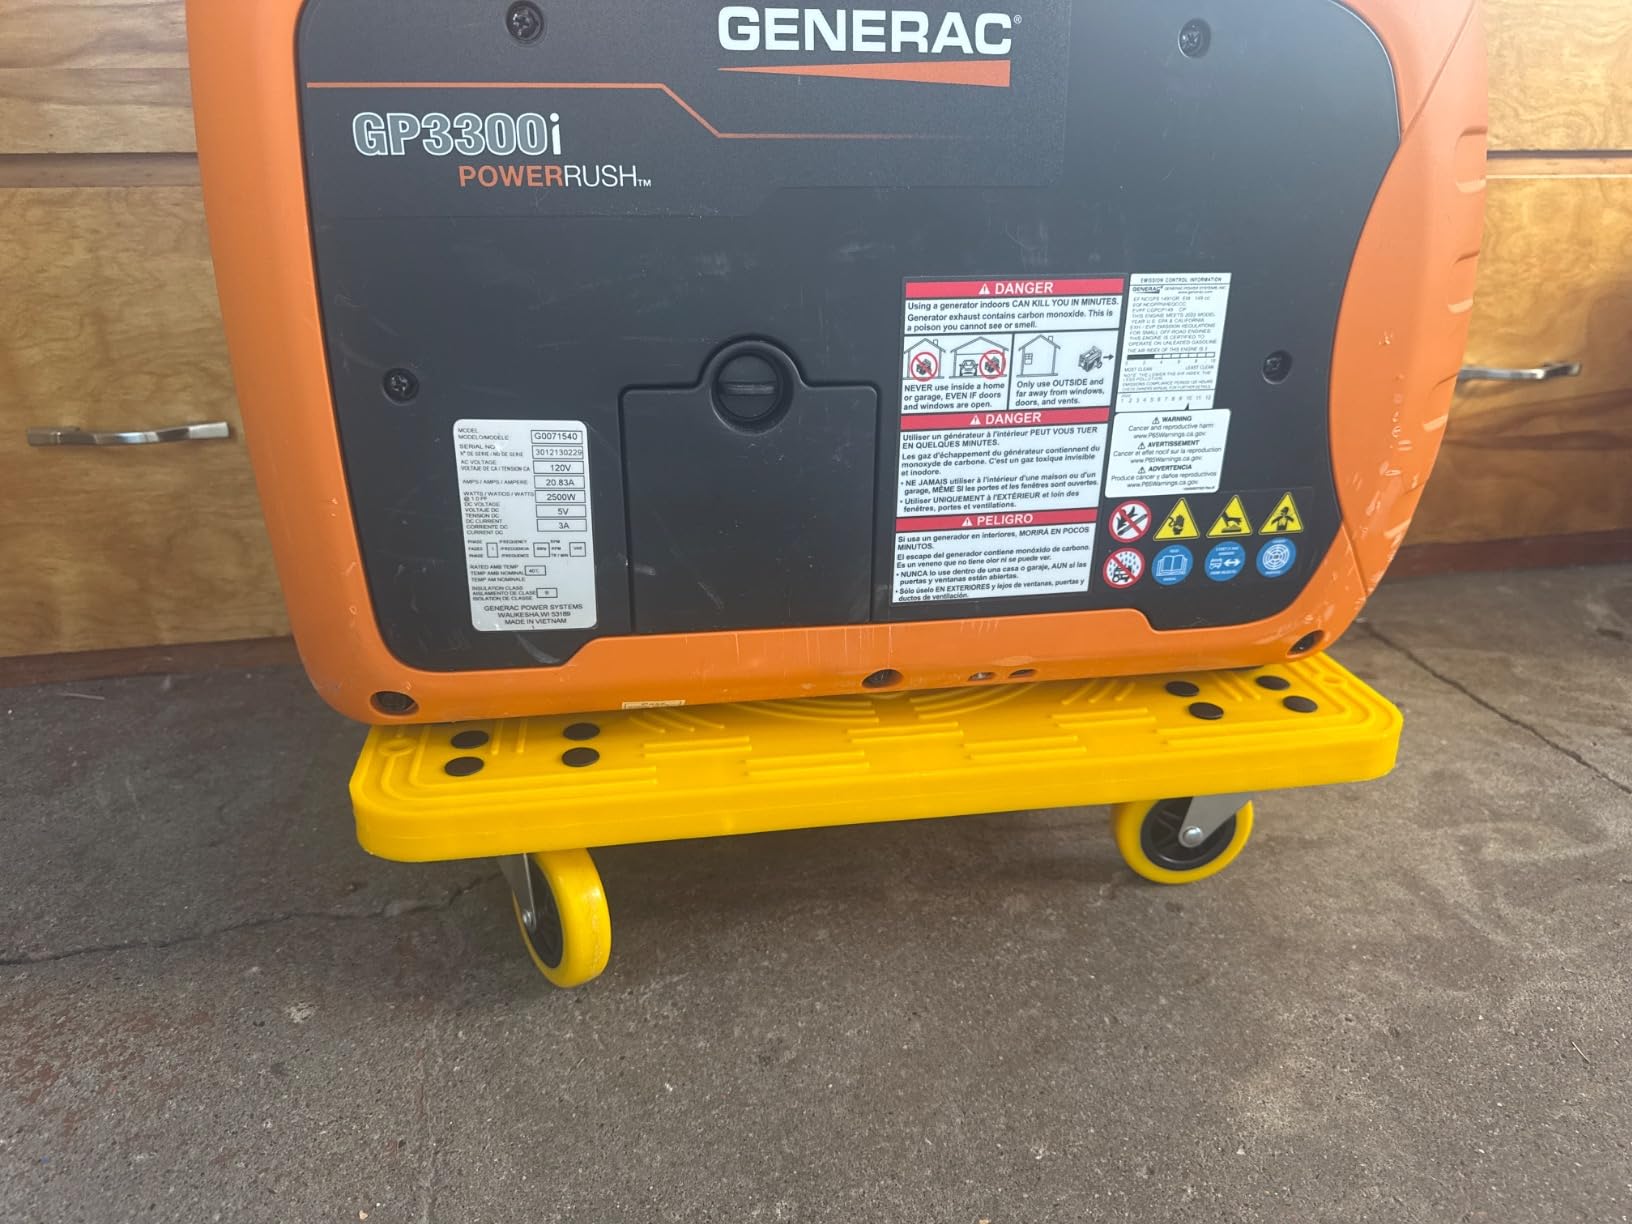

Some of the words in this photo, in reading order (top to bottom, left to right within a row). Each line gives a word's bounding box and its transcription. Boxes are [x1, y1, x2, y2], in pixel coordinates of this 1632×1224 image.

[352, 111, 560, 155] GP3300i
[995, 282, 1053, 294] DANGER
[907, 302, 931, 310] Using
[1031, 299, 1049, 307] KILL
[907, 313, 947, 321] Generator
[1017, 311, 1044, 319] carbon
[1088, 309, 1104, 317] This
[1016, 380, 1035, 389] Only
[944, 392, 967, 400] EVEN
[985, 412, 1041, 424] DANGER
[534, 432, 577, 440] G0071540
[902, 433, 930, 441] Utiliser
[992, 429, 1028, 437] l'intérieur
[1029, 428, 1050, 436] PEUT
[1052, 427, 1074, 435] VOUS
[1077, 426, 1097, 434] TUER
[915, 440, 960, 448] QUELQUES
[932, 450, 990, 458] d'échappement
[1003, 448, 1043, 456] générateur
[918, 478, 947, 486] JAMAIS
[949, 476, 975, 484] utiliser
[932, 494, 984, 503] UNIQUEMENT
[986, 494, 991, 502] à
[992, 492, 1040, 500] l'EXTÉRIEUR
[977, 514, 1033, 525] PELIGRO
